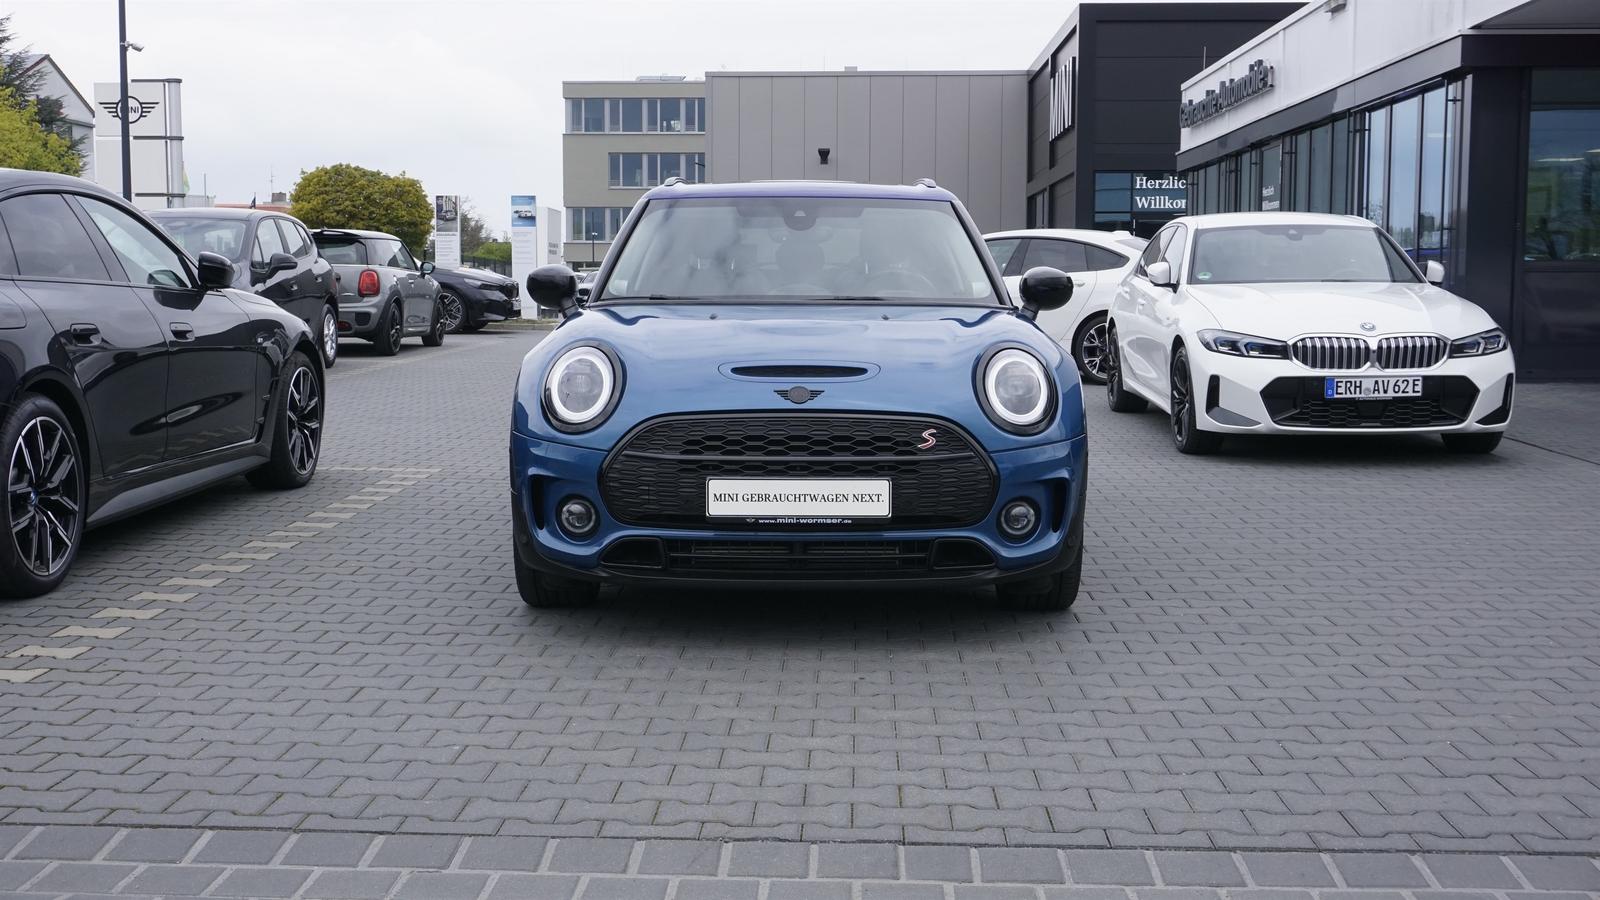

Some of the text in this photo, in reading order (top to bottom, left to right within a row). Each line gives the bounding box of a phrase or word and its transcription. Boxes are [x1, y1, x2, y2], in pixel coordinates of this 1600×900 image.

[1219, 59, 1269, 112] Automobile
[1049, 56, 1073, 142] MINI
[1335, 380, 1362, 395] ERH
[1372, 379, 1390, 395] AV
[918, 428, 937, 449] S
[713, 492, 885, 503] MINI GEBRAUCHTWAGEN NEXT.
[758, 516, 852, 524] www.mini-wormser.de
